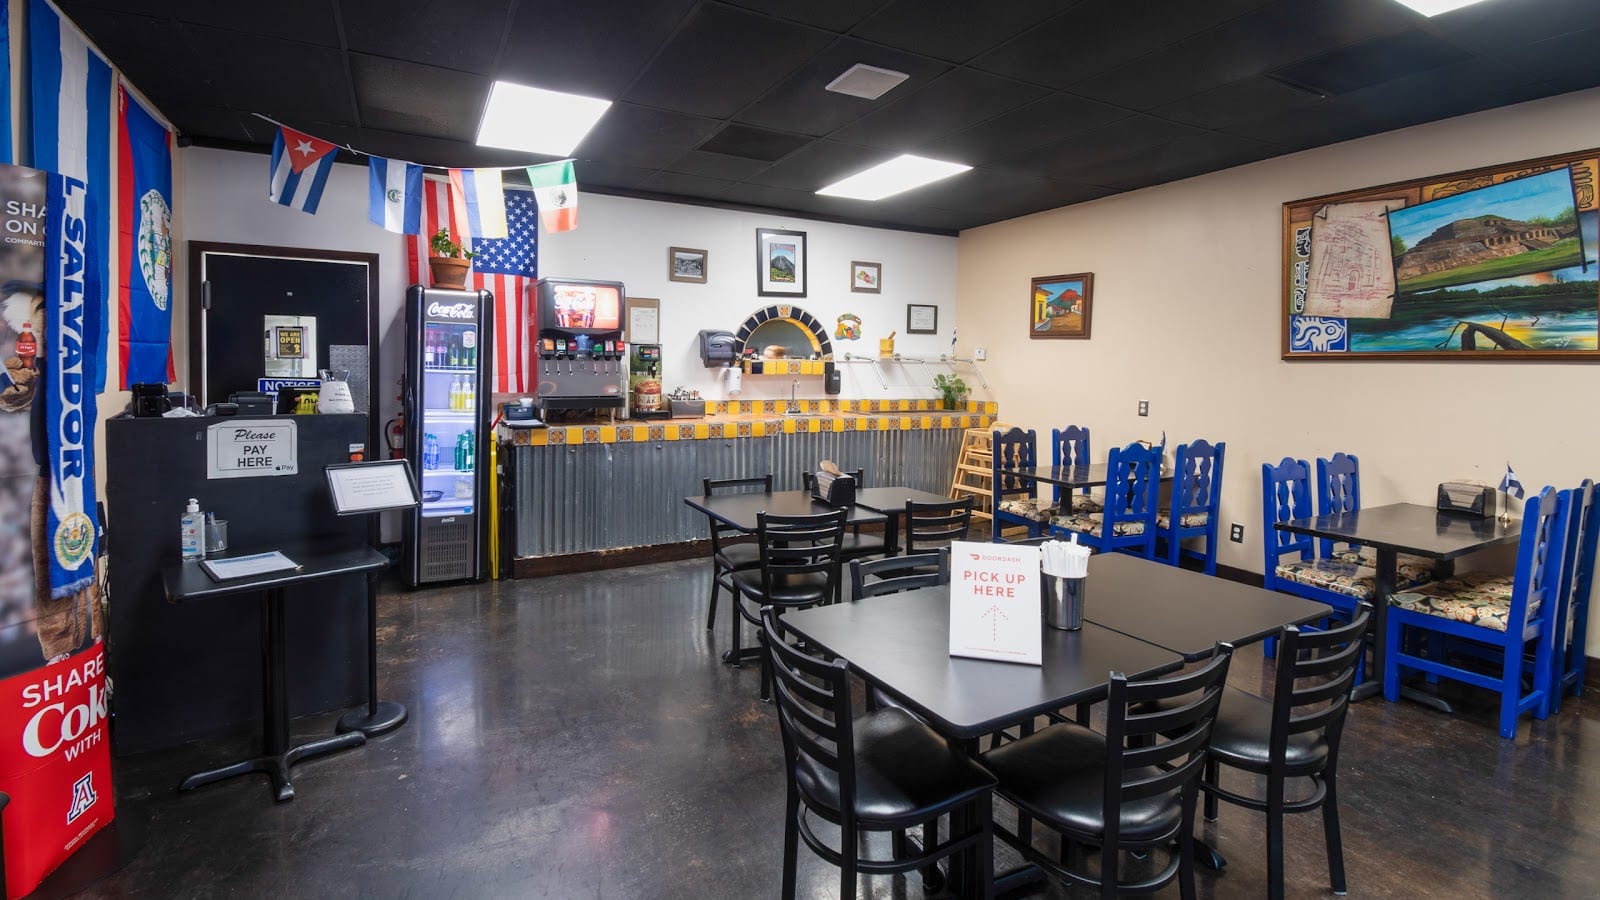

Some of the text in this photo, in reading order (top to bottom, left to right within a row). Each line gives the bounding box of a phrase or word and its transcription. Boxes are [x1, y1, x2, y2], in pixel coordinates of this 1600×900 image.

[6, 200, 46, 218] SHA
[5, 219, 37, 235] ON
[427, 301, 475, 319] Coca-Cola
[62, 174, 85, 481] L SALVADOR
[280, 336, 301, 344] OPEN
[234, 429, 277, 440] Please
[243, 445, 267, 455] PAY
[237, 457, 273, 467] HERE
[964, 570, 1026, 584] PICK UP
[974, 585, 1015, 598] HERE
[22, 652, 104, 708] SHARE
[22, 683, 108, 758] Cok
[64, 728, 101, 762] WITH
